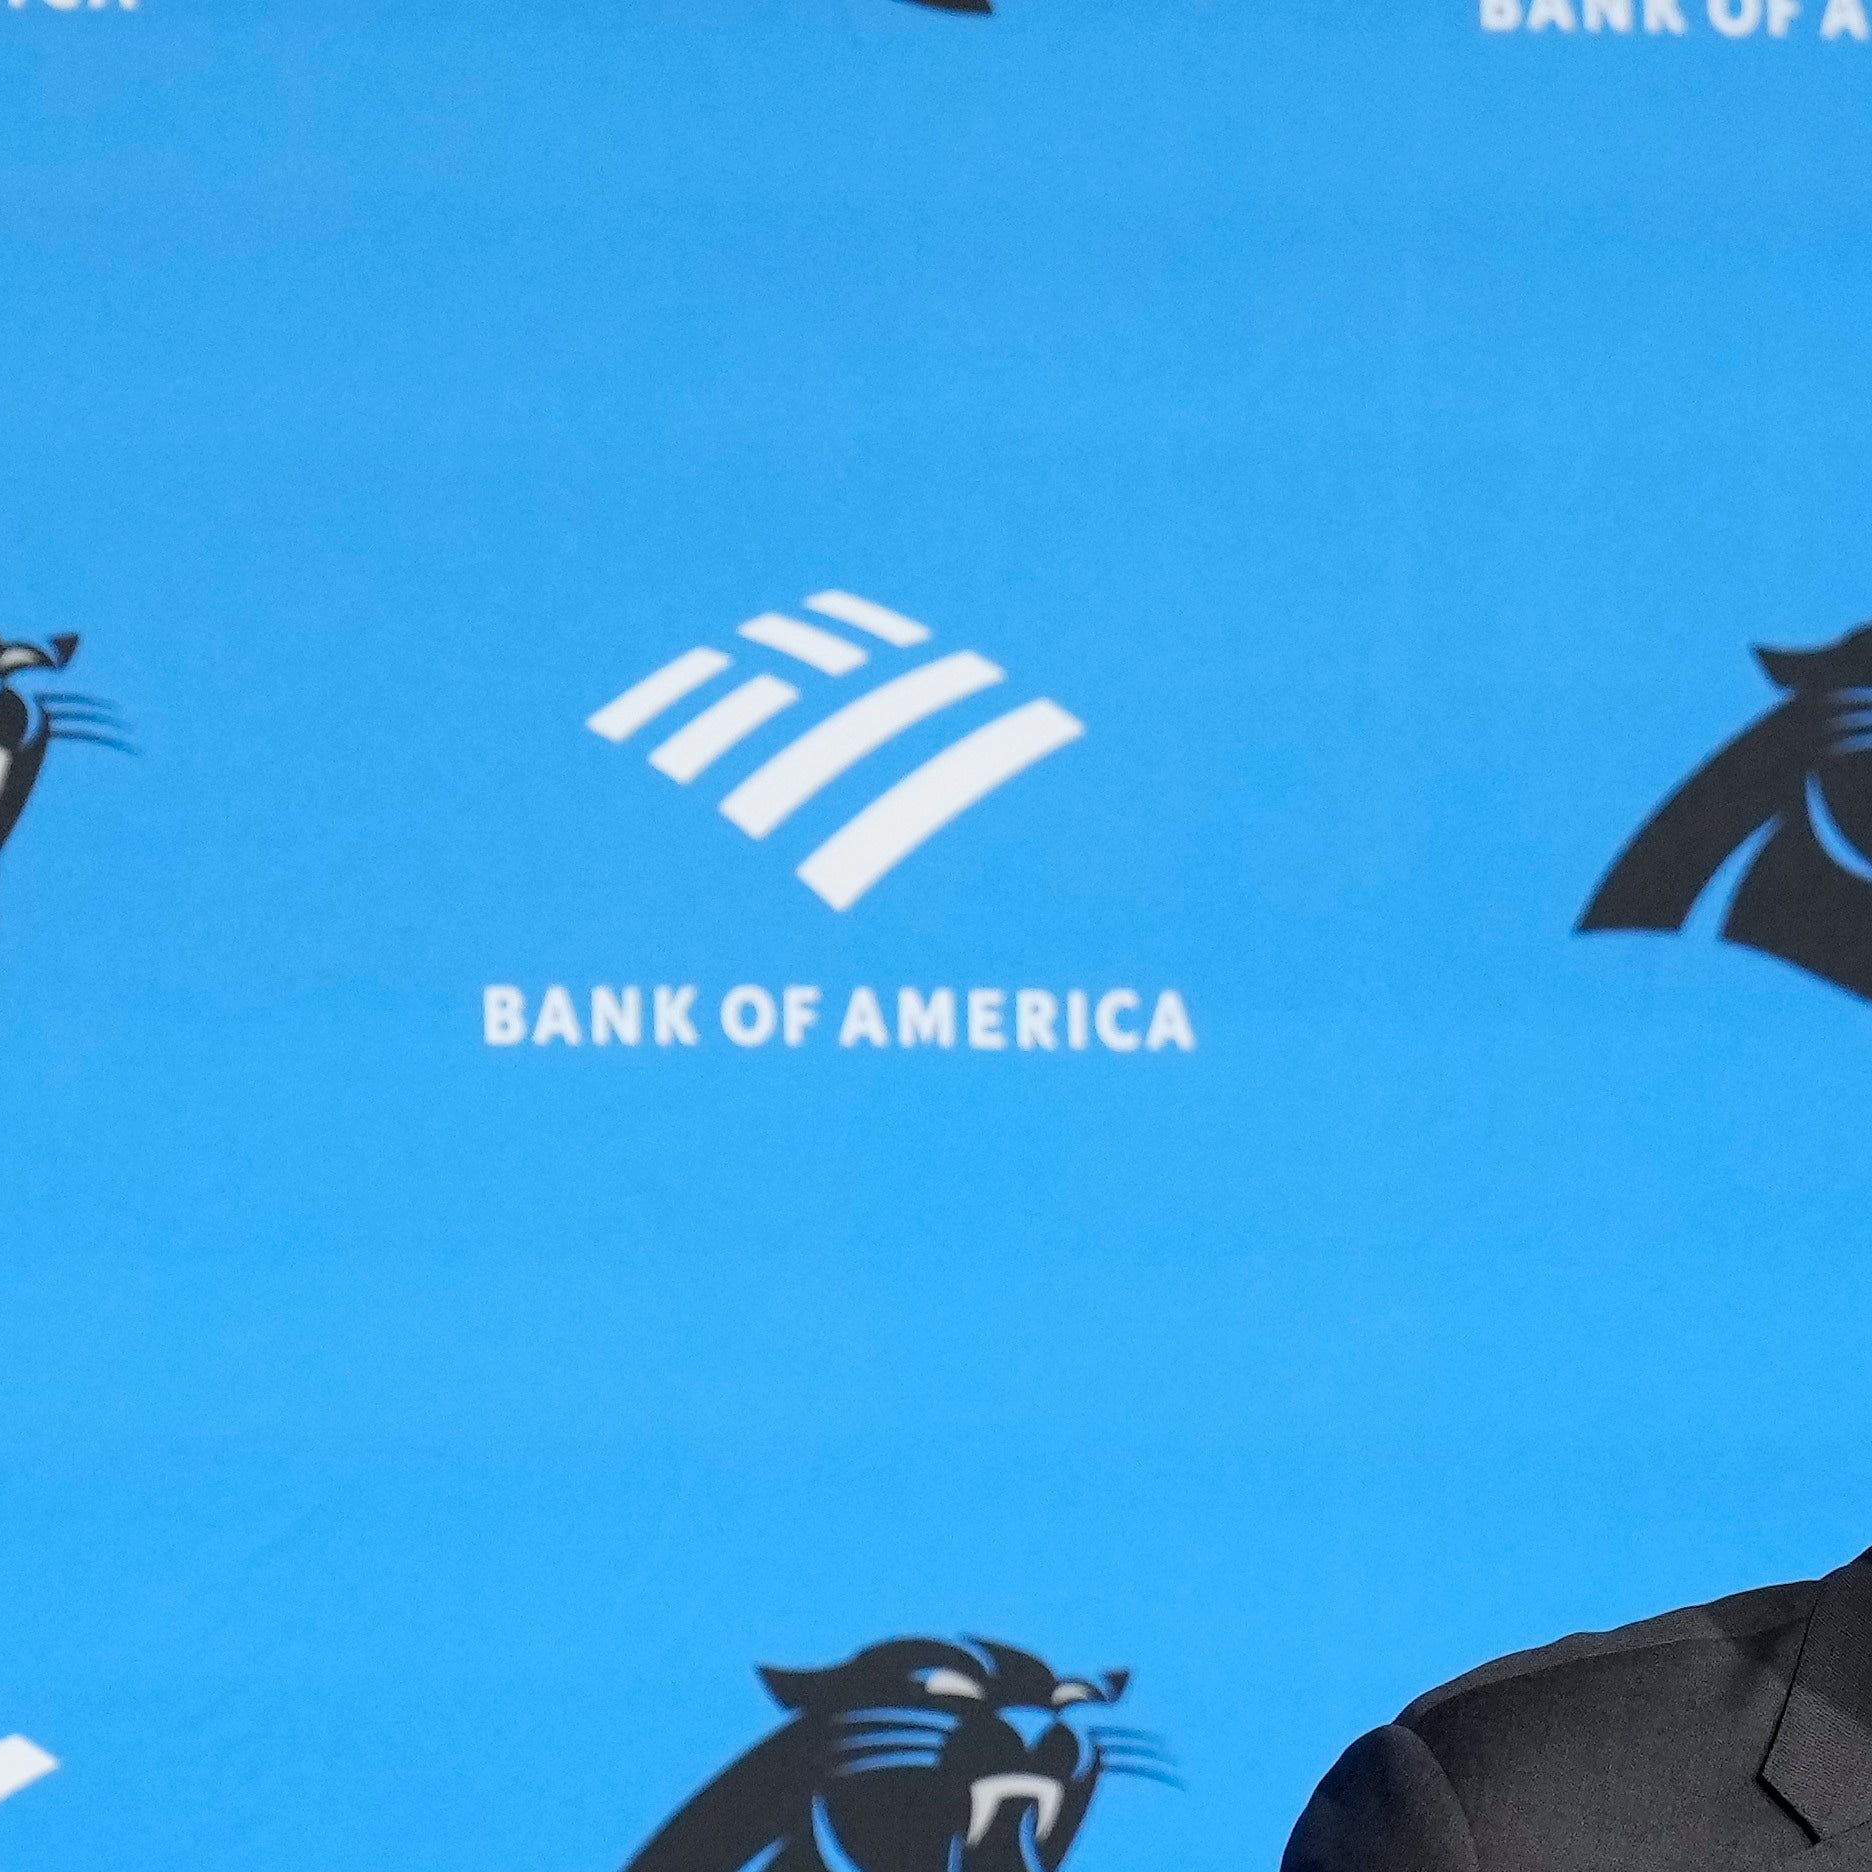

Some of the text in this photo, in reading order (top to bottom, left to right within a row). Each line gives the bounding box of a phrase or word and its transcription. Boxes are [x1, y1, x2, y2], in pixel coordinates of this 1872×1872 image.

[483, 984, 1196, 1053] BANK OF AMERICA
